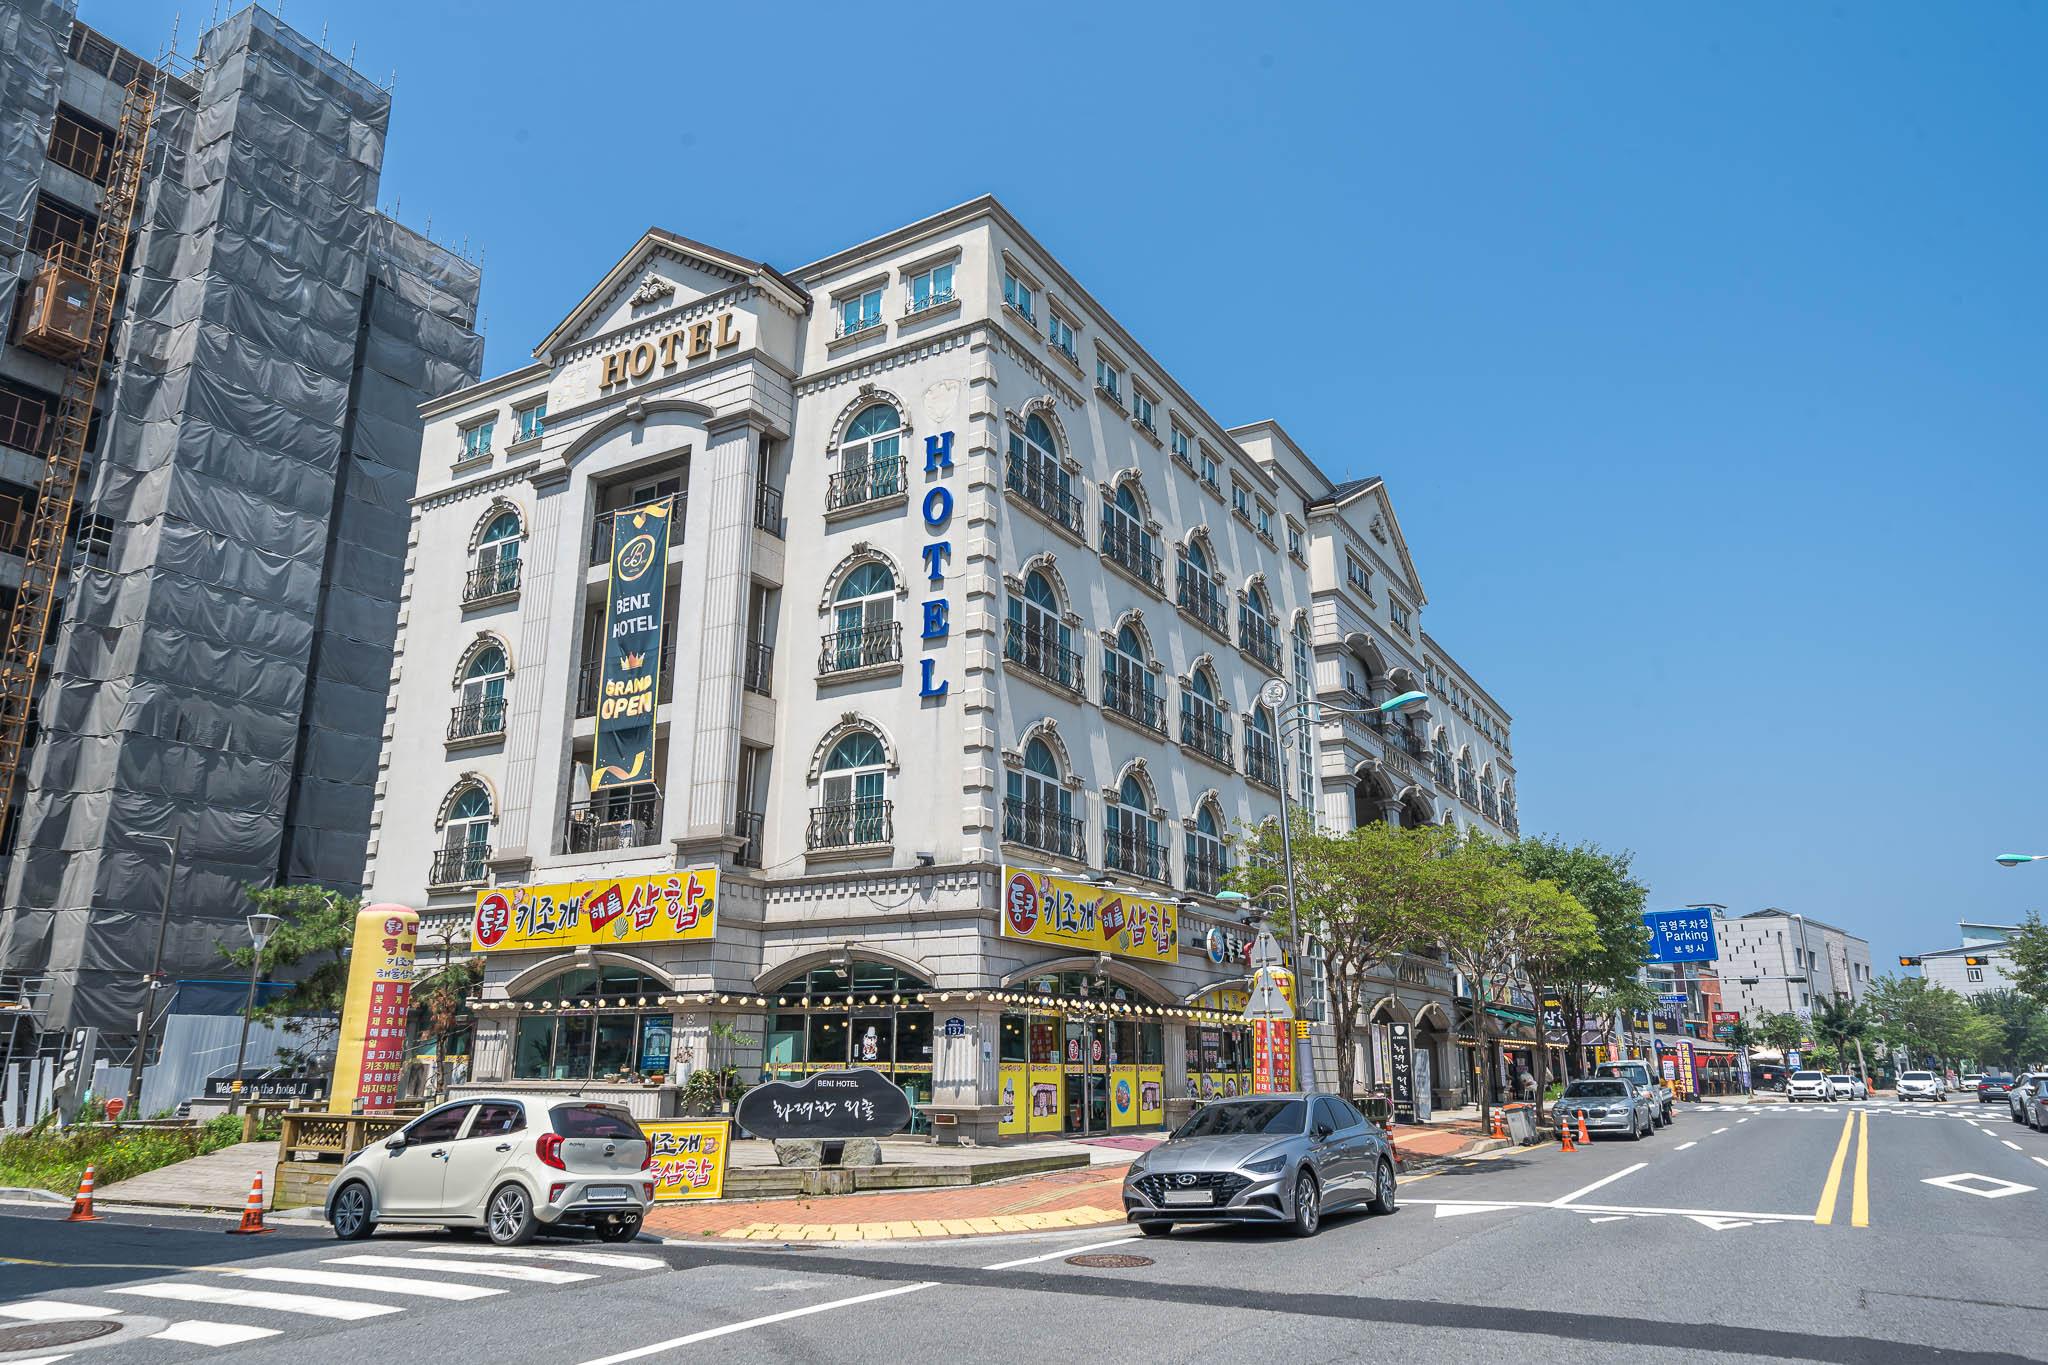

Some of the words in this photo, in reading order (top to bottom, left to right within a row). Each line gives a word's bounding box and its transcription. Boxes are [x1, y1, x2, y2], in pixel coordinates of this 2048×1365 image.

[599, 313, 741, 389] HOTEL
[919, 431, 955, 697] HOTEL
[616, 592, 651, 615] BENI
[612, 615, 658, 639] HOTEL
[605, 675, 652, 697] GRAND
[601, 692, 652, 720] OPEN
[480, 902, 509, 938] 통큰
[514, 895, 581, 936] 키조개
[590, 893, 623, 920] 해물
[625, 872, 707, 932] 삼합
[1010, 882, 1038, 923] 통큰
[1043, 888, 1096, 933] 키조개
[1102, 907, 1125, 929] 해물
[1126, 904, 1173, 955] 삼합
[1659, 918, 1709, 932] 공영주차장
[1665, 930, 1709, 942] Parking
[382, 938, 417, 955] 뚝배
[1674, 944, 1705, 953] 보령시
[376, 968, 416, 979] 해물삼
[947, 1027, 962, 1035] 137
[260, 1083, 274, 1094] the
[275, 1083, 297, 1095] hotel
[817, 1079, 834, 1087] BENI
[836, 1080, 859, 1088] HOTEL
